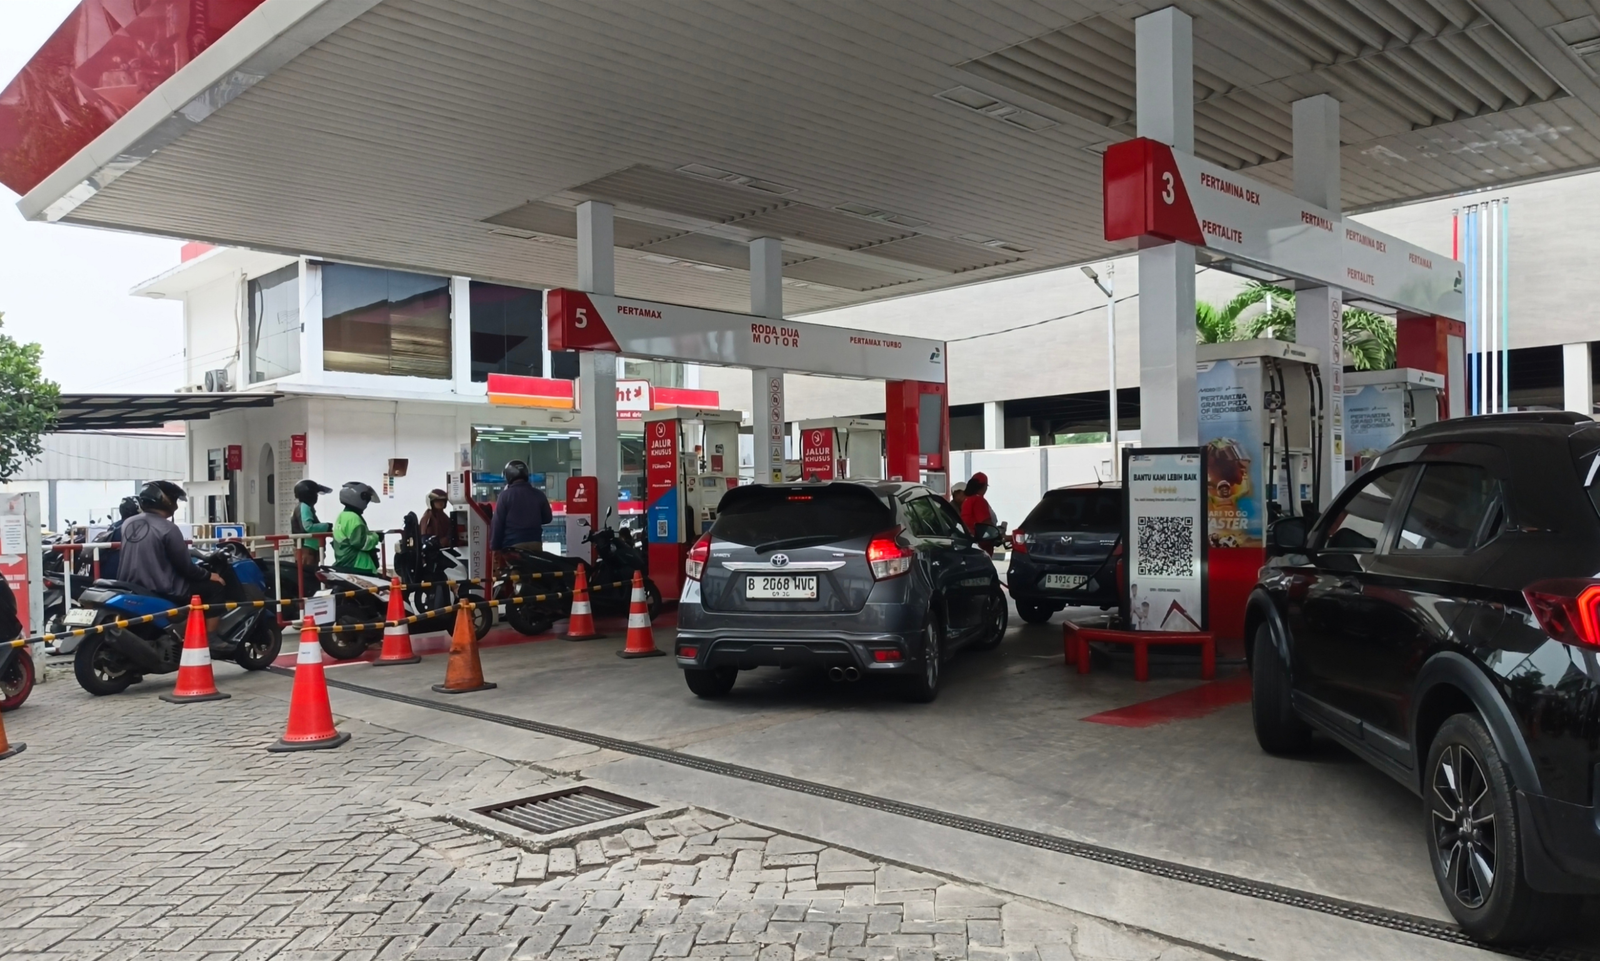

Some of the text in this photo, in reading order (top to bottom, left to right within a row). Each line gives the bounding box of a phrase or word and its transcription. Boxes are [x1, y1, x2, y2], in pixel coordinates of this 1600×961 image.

[1162, 171, 1175, 205] 3
[1200, 172, 1260, 206] PERTAMINA DEX
[1301, 210, 1334, 233] PERTAMAX
[1202, 219, 1243, 244] PERTALITE
[1345, 229, 1387, 253] PERTAMINA DEX
[1408, 252, 1433, 270] PERTAMAX
[1347, 267, 1375, 286] PERTALITE
[574, 308, 588, 329] 5
[617, 305, 662, 319] PERTAMAX
[751, 323, 800, 339] RODA DUA
[752, 333, 799, 348] MOTOR
[849, 336, 902, 349] PERTAMAX TURBO
[1200, 393, 1247, 402] PERTAMINA
[1212, 405, 1253, 414] INDONESIA
[651, 439, 672, 449] JALUR
[805, 447, 830, 455] JALUR
[651, 448, 672, 456] KHUSUS
[1184, 473, 1198, 481] BAIK
[1208, 517, 1249, 529] ASTER
[472, 525, 480, 545] SELF
[472, 550, 480, 580] SERVIC
[748, 577, 814, 590] B 2068 WVC
[1047, 575, 1052, 583] B
